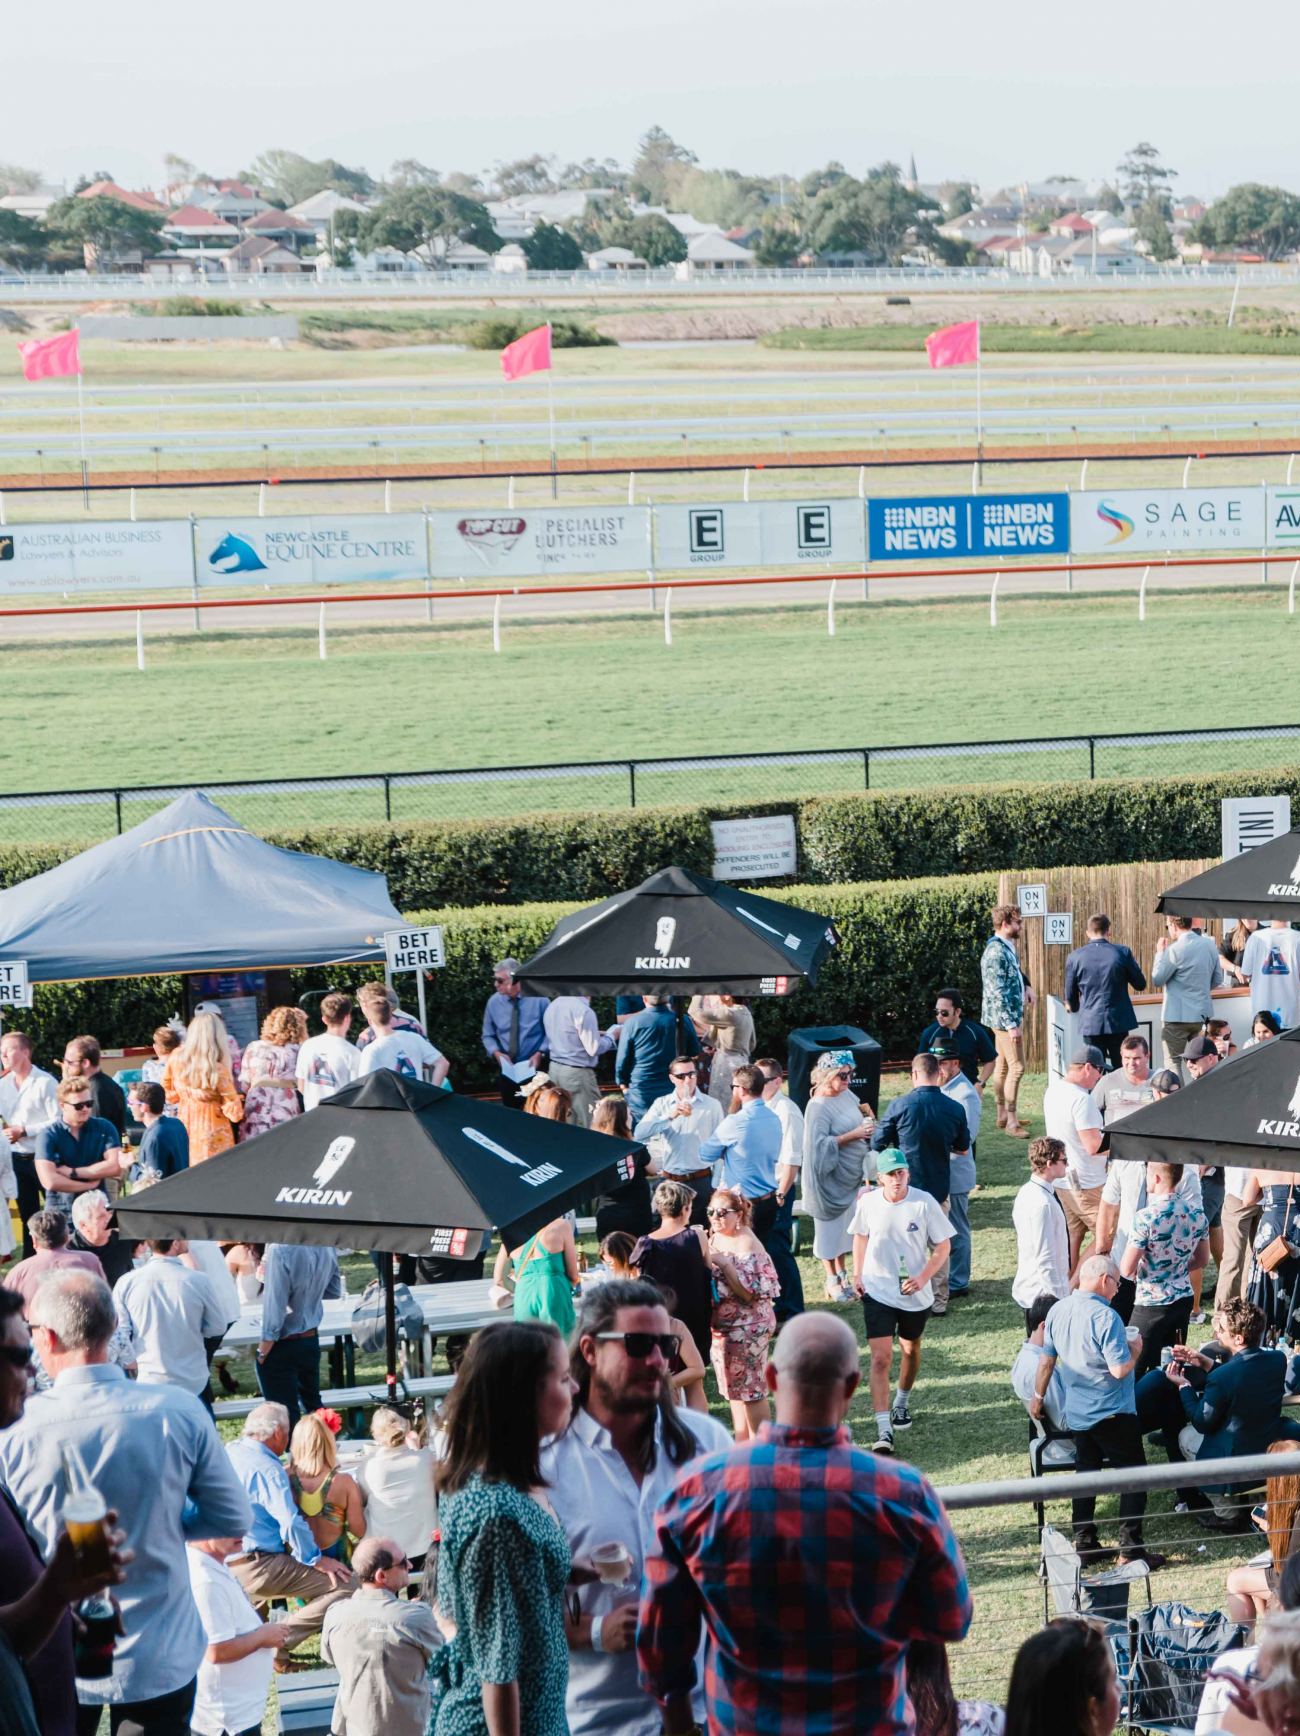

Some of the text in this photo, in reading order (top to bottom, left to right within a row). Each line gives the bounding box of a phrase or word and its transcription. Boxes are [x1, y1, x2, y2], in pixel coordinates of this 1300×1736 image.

[905, 506, 956, 528] NBN
[1003, 502, 1054, 524] NBN
[1145, 501, 1242, 523] SAGE
[546, 517, 625, 533] PECIALIST
[695, 515, 718, 547] E
[803, 512, 826, 543] E
[1147, 528, 1241, 538] PAINTING
[20, 530, 161, 546] AUSTRALIAN BUSINESS
[265, 531, 349, 543] NEWCASTLE
[885, 528, 957, 550] NEWS
[983, 525, 1055, 547] NEWS
[266, 540, 415, 562] EQUINE CENTRE
[690, 554, 725, 563] GROUP
[797, 550, 832, 559] GROUP
[1239, 811, 1274, 853] TINI
[716, 855, 761, 864] OFFENDERS
[762, 852, 779, 861] WILL
[730, 863, 780, 872] PROSECUTED
[1025, 891, 1039, 900] ON
[1025, 902, 1039, 910] YX
[1051, 919, 1065, 928] ON
[399, 932, 429, 949] BET
[1051, 930, 1065, 938] YX
[395, 949, 439, 967] HERE
[634, 957, 691, 969] KIRIN
[0, 985, 21, 1000] RE
[519, 1162, 563, 1187] KIRIN
[275, 1186, 354, 1207] KIRIN
[430, 1236, 451, 1245] PRESS
[434, 1229, 453, 1237] FIRST
